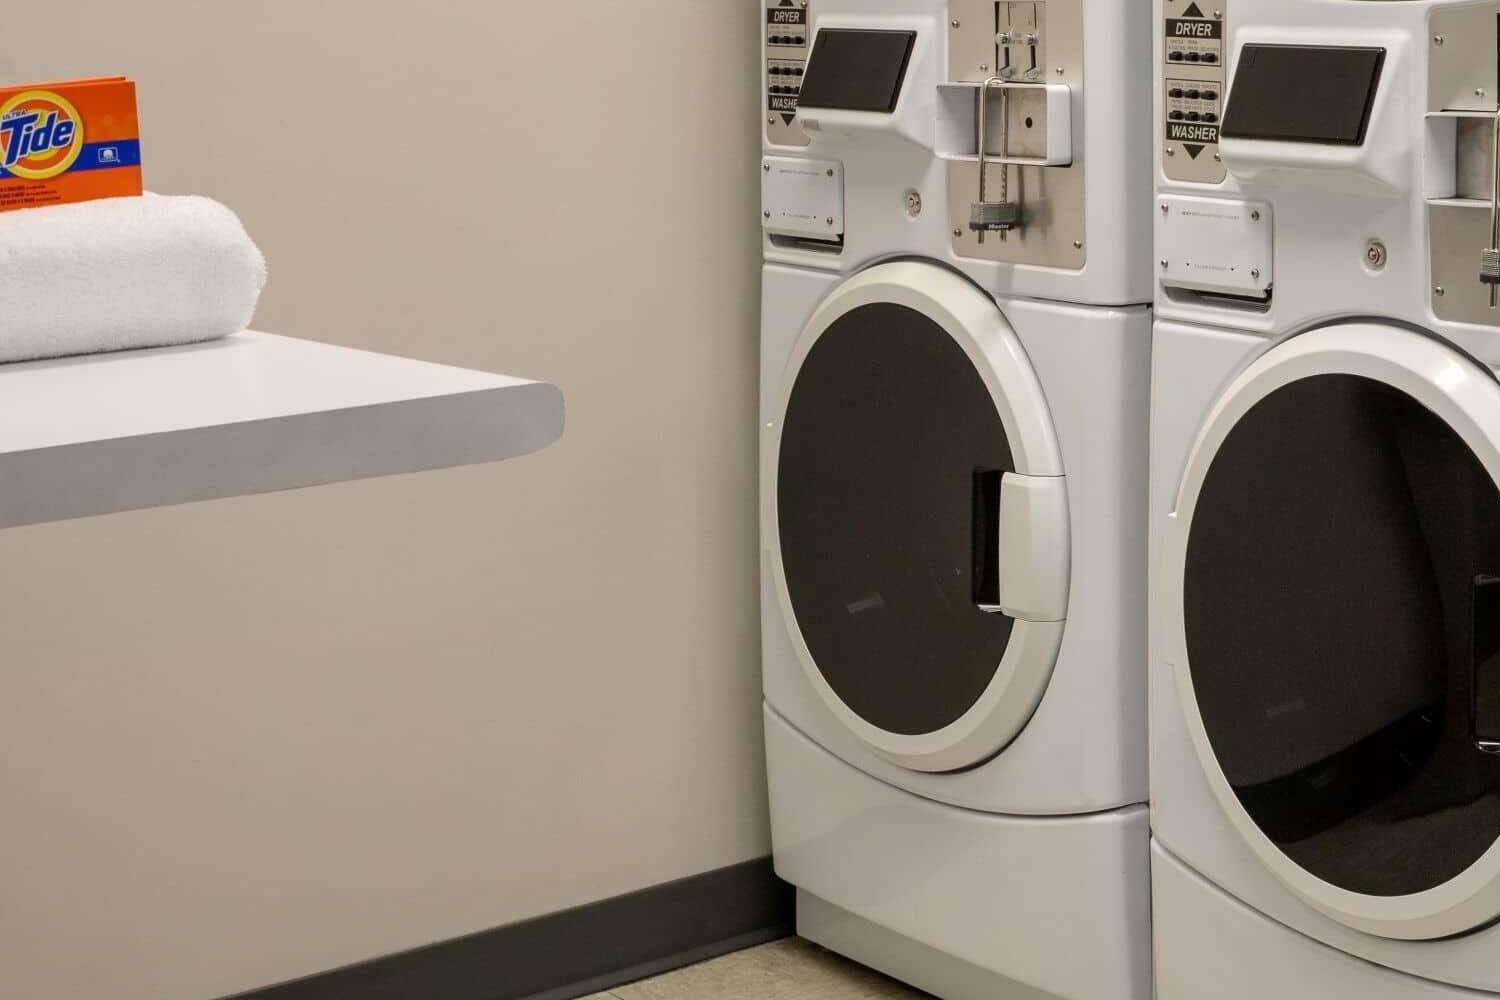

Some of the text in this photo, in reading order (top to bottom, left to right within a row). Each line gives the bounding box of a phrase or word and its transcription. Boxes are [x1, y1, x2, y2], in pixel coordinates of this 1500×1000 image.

[774, 10, 800, 23] DRYER
[1175, 22, 1213, 37] DRYER
[771, 96, 799, 110] WASHE
[0, 111, 75, 167] Tide
[1171, 124, 1217, 141] WASHER
